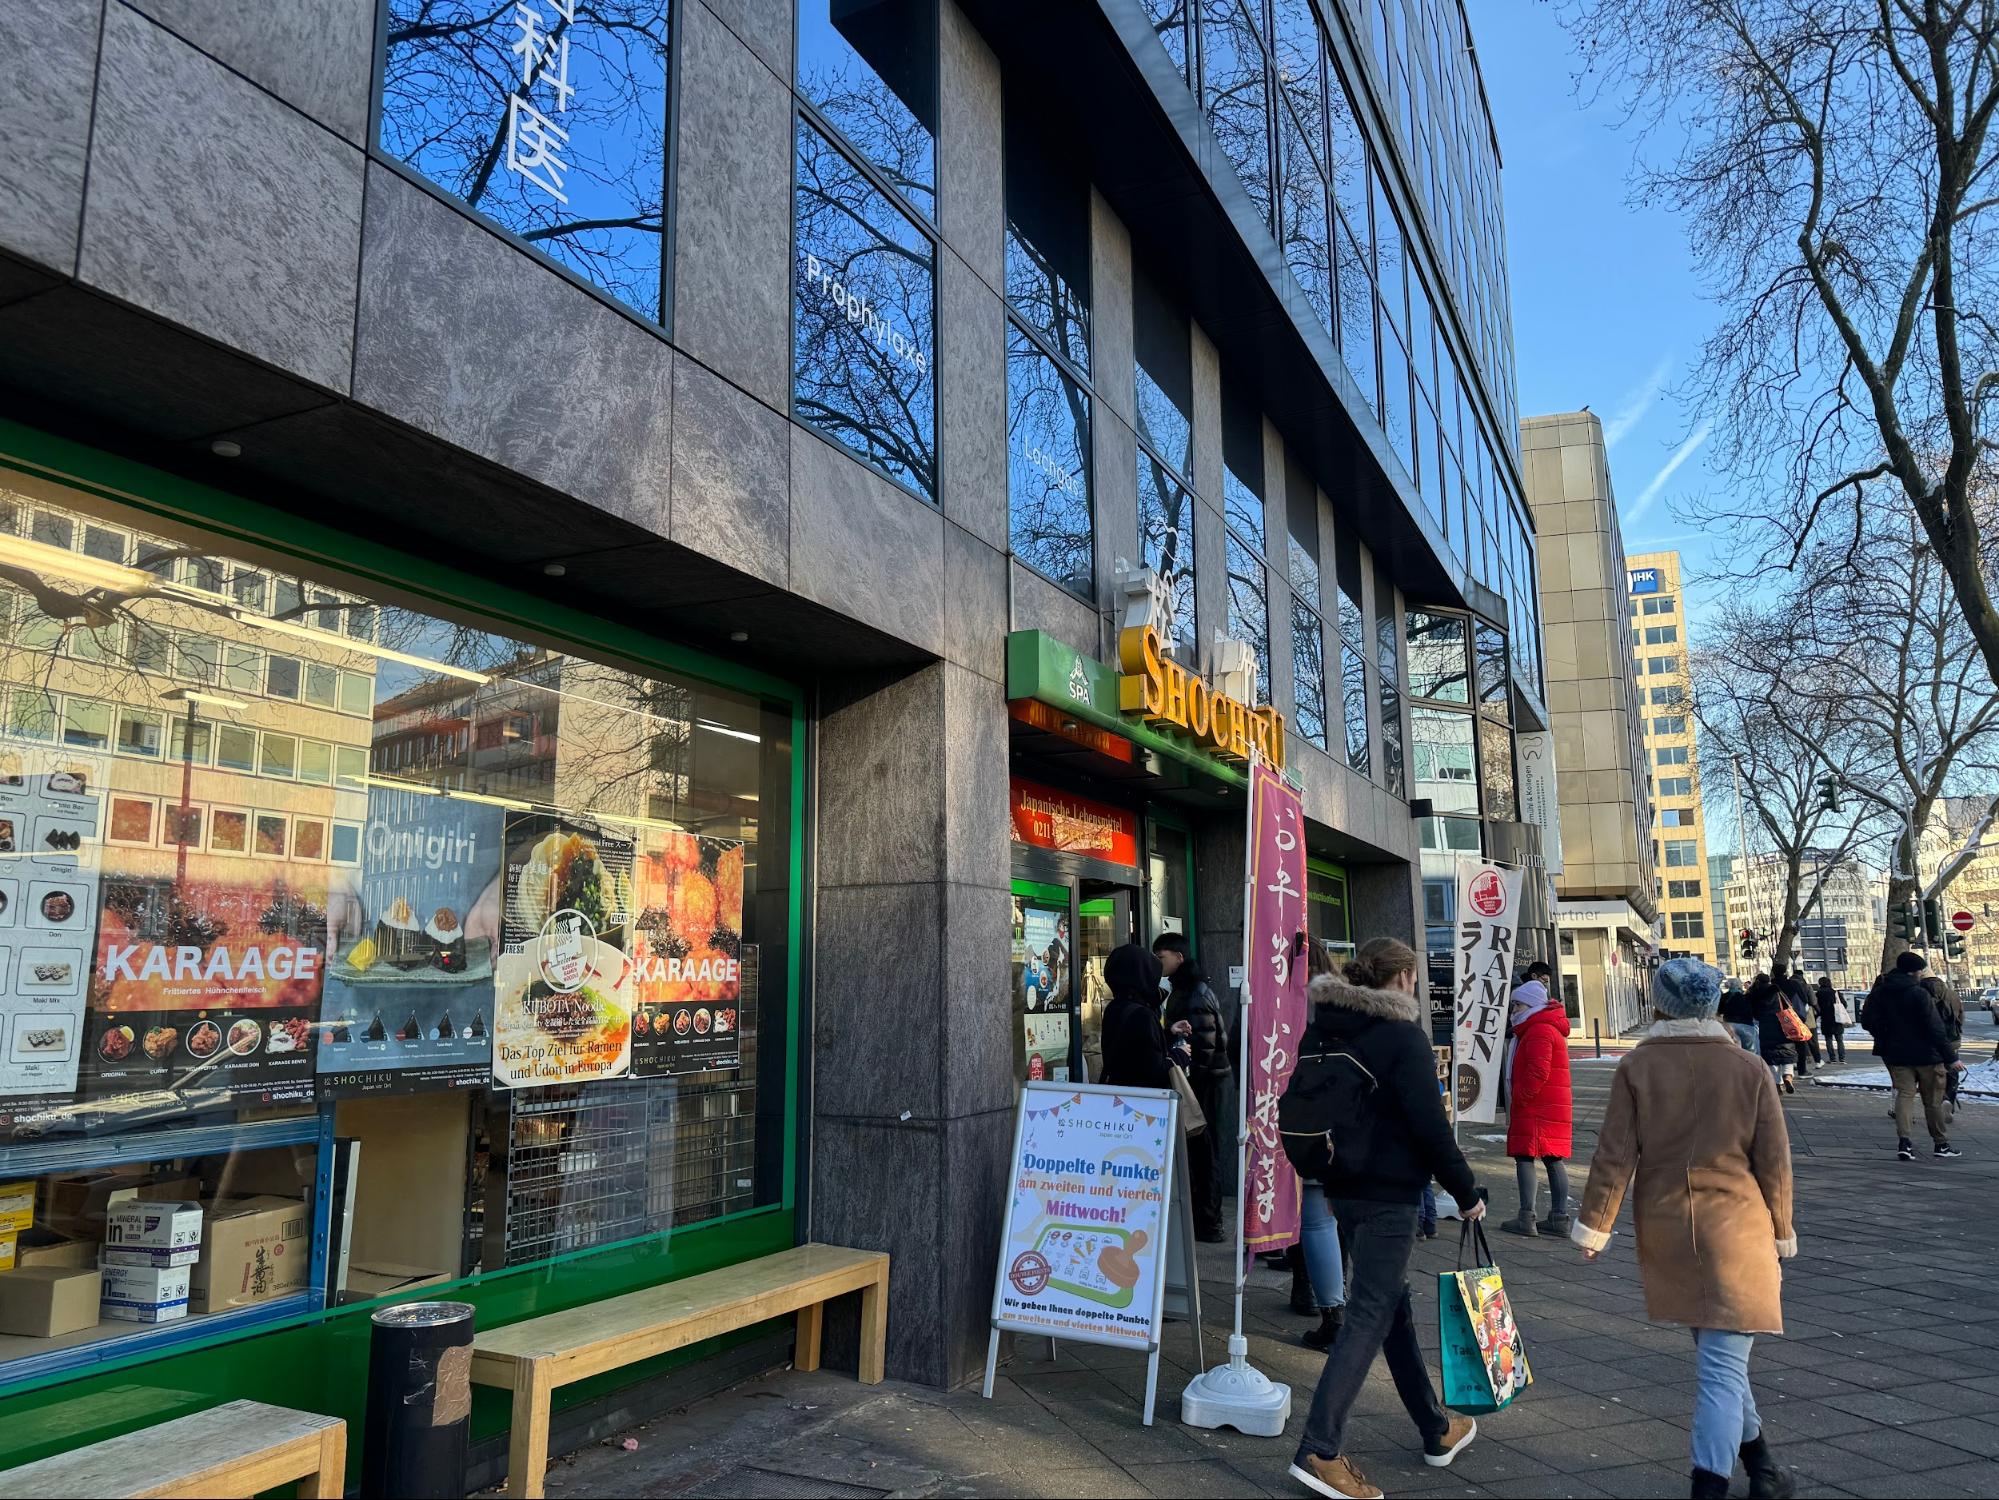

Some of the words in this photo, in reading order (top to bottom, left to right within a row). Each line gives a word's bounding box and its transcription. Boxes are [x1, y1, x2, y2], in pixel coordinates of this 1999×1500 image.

[507, 0, 574, 204] 科医
[808, 253, 926, 373] Prophylaxe
[1025, 436, 1079, 496] Lachgas
[1633, 570, 1655, 582] IHK
[1524, 765, 1533, 797] Kollegen
[1021, 788, 1070, 818] Japanische
[1033, 820, 1051, 839] 0211
[611, 913, 628, 924] VEGAN
[505, 944, 526, 954] FRESH
[104, 944, 318, 982] KARAAGE
[636, 957, 738, 982] KARAAGE
[1457, 921, 1482, 1027] ラーメン
[163, 987, 202, 995] Frittiertes
[205, 986, 268, 995] Hühnchenfleisch
[1468, 924, 1513, 1063] RAMEN
[522, 1000, 570, 1015] KUBOTA
[502, 1046, 522, 1060] Das
[524, 1044, 545, 1061] Top
[547, 1043, 567, 1056] Ziel
[569, 1042, 585, 1055] für
[587, 1040, 622, 1053] Ramen
[639, 1055, 676, 1065] SHOCHIKU
[333, 1073, 393, 1085] SHOCHIKU
[510, 1064, 531, 1079] und
[534, 1063, 563, 1077] Udon
[565, 1062, 576, 1074] in
[578, 1060, 613, 1075] Europa
[455, 1077, 490, 1087] shochiku_de
[271, 1089, 315, 1101] shochiku_de
[1068, 1119, 1135, 1132] SHOCHIKU
[1024, 1153, 1096, 1175] Doppelte
[1101, 1160, 1160, 1181] Punkte
[1018, 1178, 1037, 1189] am
[1040, 1180, 1085, 1194] zweiten
[1090, 1186, 1113, 1197] und
[1118, 1186, 1162, 1202] vierten
[116, 1215, 142, 1223] MINERAL
[1046, 1199, 1127, 1223] Mittwoch!
[108, 1217, 123, 1242] in
[105, 1268, 128, 1277] ENERGY
[1004, 1298, 1020, 1308] Wir
[1021, 1300, 1047, 1311] geben
[1049, 1304, 1073, 1315] Ihnen
[1075, 1308, 1115, 1321] doppelte
[1002, 1312, 1016, 1320] am
[1018, 1313, 1051, 1325] zweiten
[1053, 1318, 1070, 1328] und
[1071, 1320, 1103, 1332] vierten
